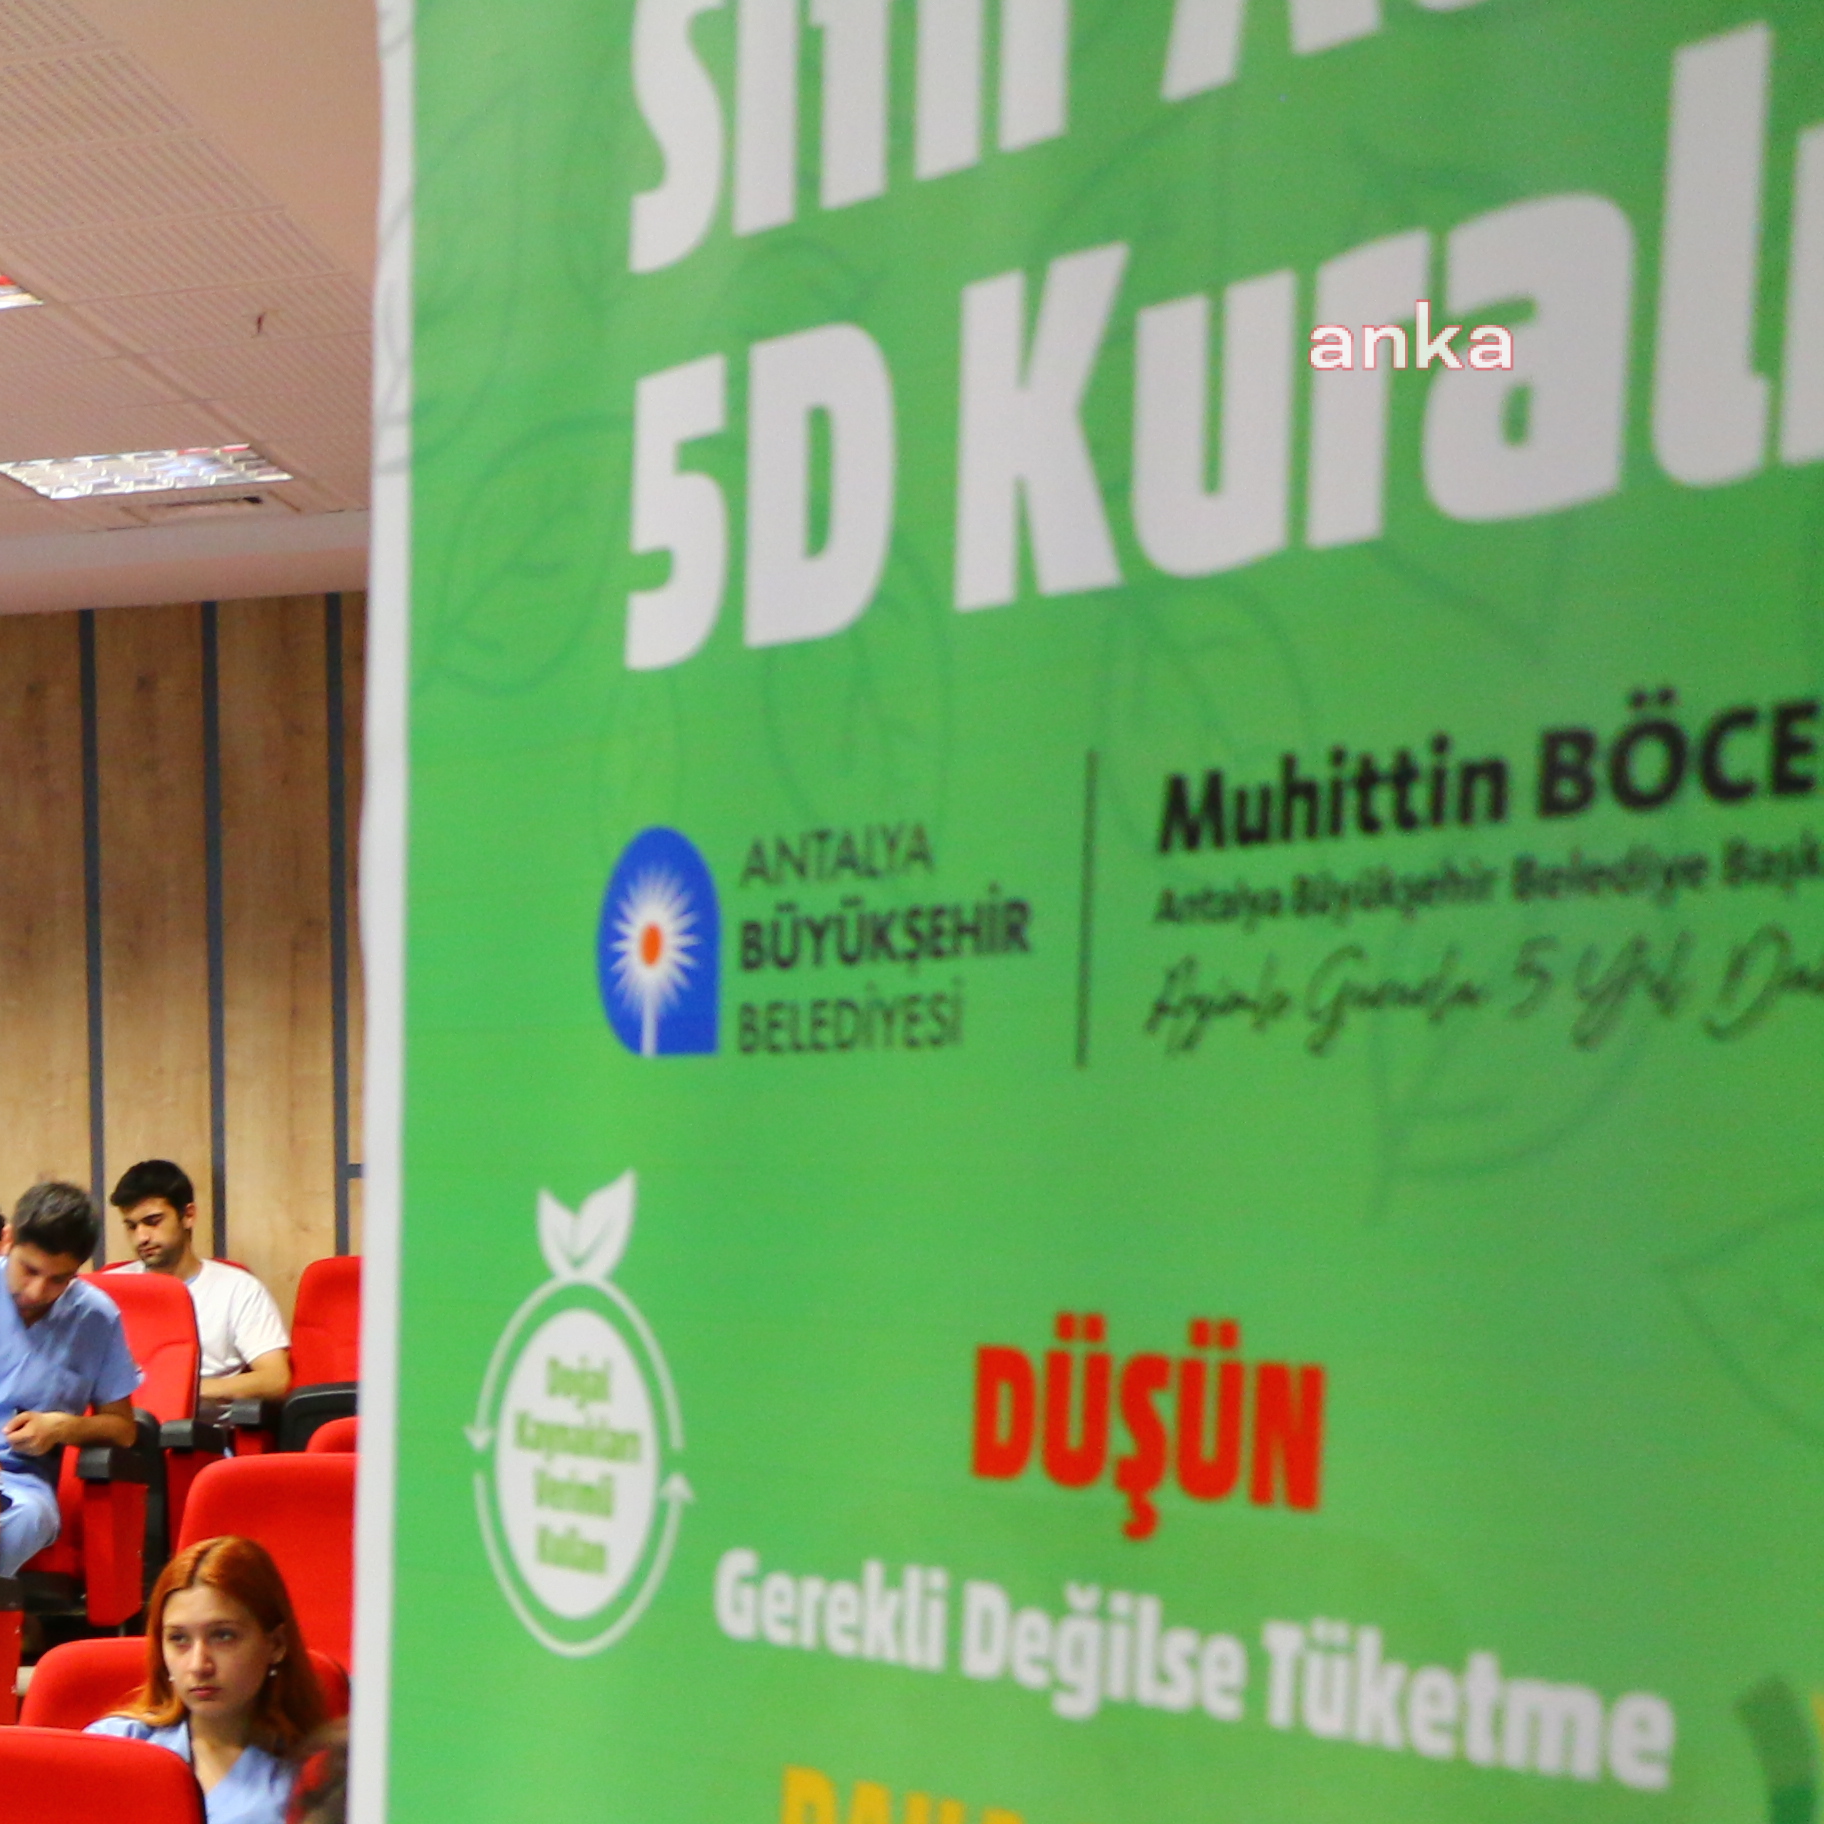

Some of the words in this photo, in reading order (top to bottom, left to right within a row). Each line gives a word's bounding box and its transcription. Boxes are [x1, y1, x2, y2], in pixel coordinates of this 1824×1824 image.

[624, 320, 896, 671] 5D
[737, 822, 934, 888] ANTALYA
[1156, 730, 1510, 856] Muhittin
[738, 880, 1033, 976] BÜYÜKŞEHİR
[736, 975, 965, 1056] BELEDİYESİ
[970, 1309, 1328, 1542] DÜŞÜN
[712, 1544, 948, 1674] Gerekli
[960, 1578, 1248, 1724] Değilse
[1260, 1615, 1676, 1791] Tüketme
